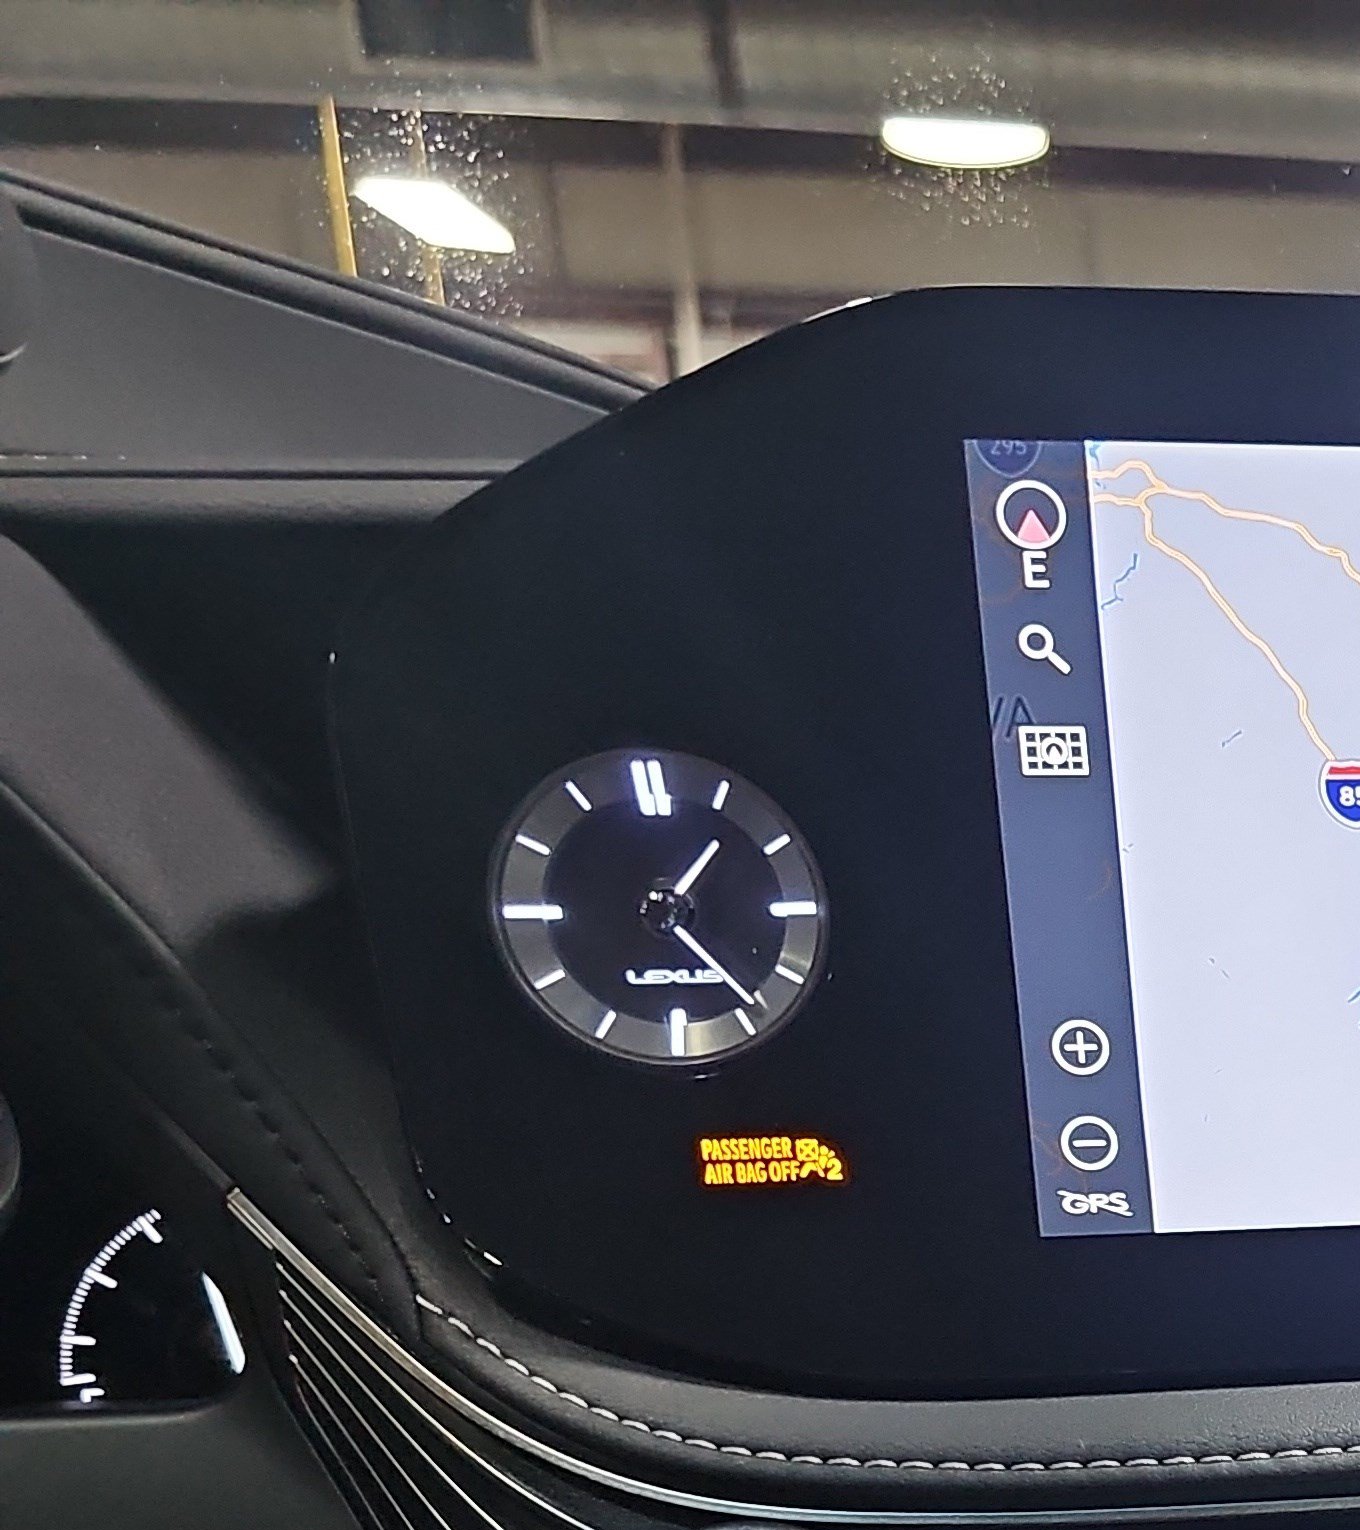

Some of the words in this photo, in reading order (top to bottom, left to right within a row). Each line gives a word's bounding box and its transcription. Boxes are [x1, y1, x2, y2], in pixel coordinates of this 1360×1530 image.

[1022, 550, 1050, 589] E
[625, 969, 724, 985] LEXUS
[700, 1137, 793, 1161] PASSENGER
[704, 1161, 734, 1185] AIR
[735, 1160, 767, 1184] BAG
[768, 1160, 799, 1182] OFF
